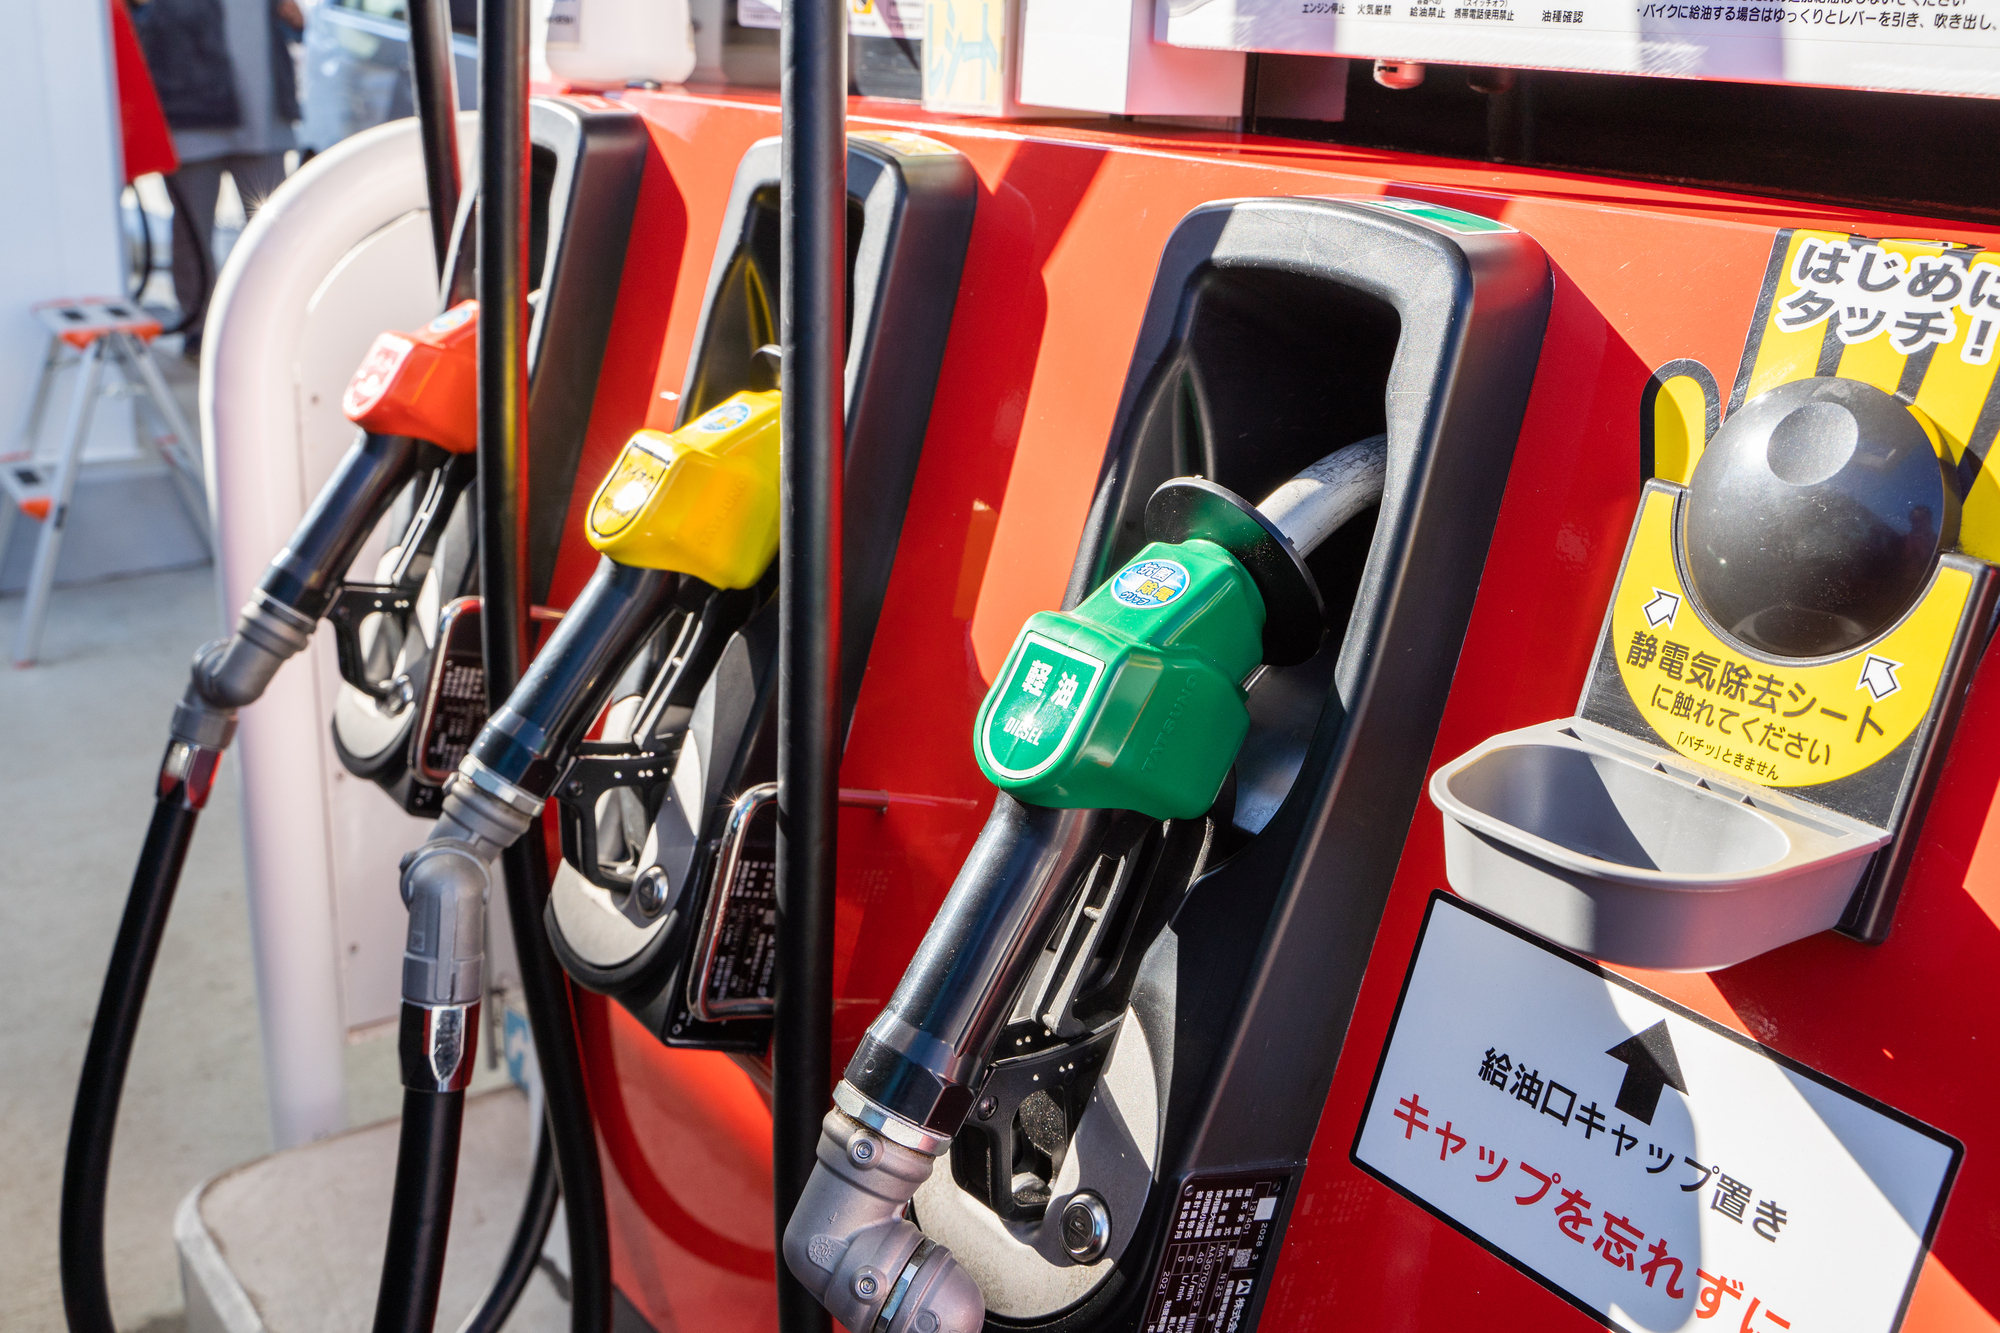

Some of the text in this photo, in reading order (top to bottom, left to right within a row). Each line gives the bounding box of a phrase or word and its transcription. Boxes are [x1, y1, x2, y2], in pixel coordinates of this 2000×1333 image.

[1302, 3, 1345, 15] エンジン停止
[1357, 4, 1392, 16] 火気厳禁
[1410, 7, 1445, 19] 給油禁止
[1454, 8, 1514, 21] 携帯電話使用禁止
[1541, 10, 1584, 24] 油種確認
[1021, 659, 1079, 709] 軽油
[1626, 629, 1884, 743] 静電気除去シート
[1003, 716, 1040, 747] DIESEL
[1141, 673, 1198, 773] TATSUNO
[1650, 683, 1830, 765] に触れてください
[1676, 731, 1779, 781] 「パチッ」ときません
[1476, 1046, 1788, 1243] 給油口キャップ置き
[1243, 1200, 1258, 1235] 131401
[1393, 1093, 1792, 1333] キャップを忘れずに
[1256, 1222, 1268, 1247] 2028
[1158, 1271, 1171, 1295] 2021
